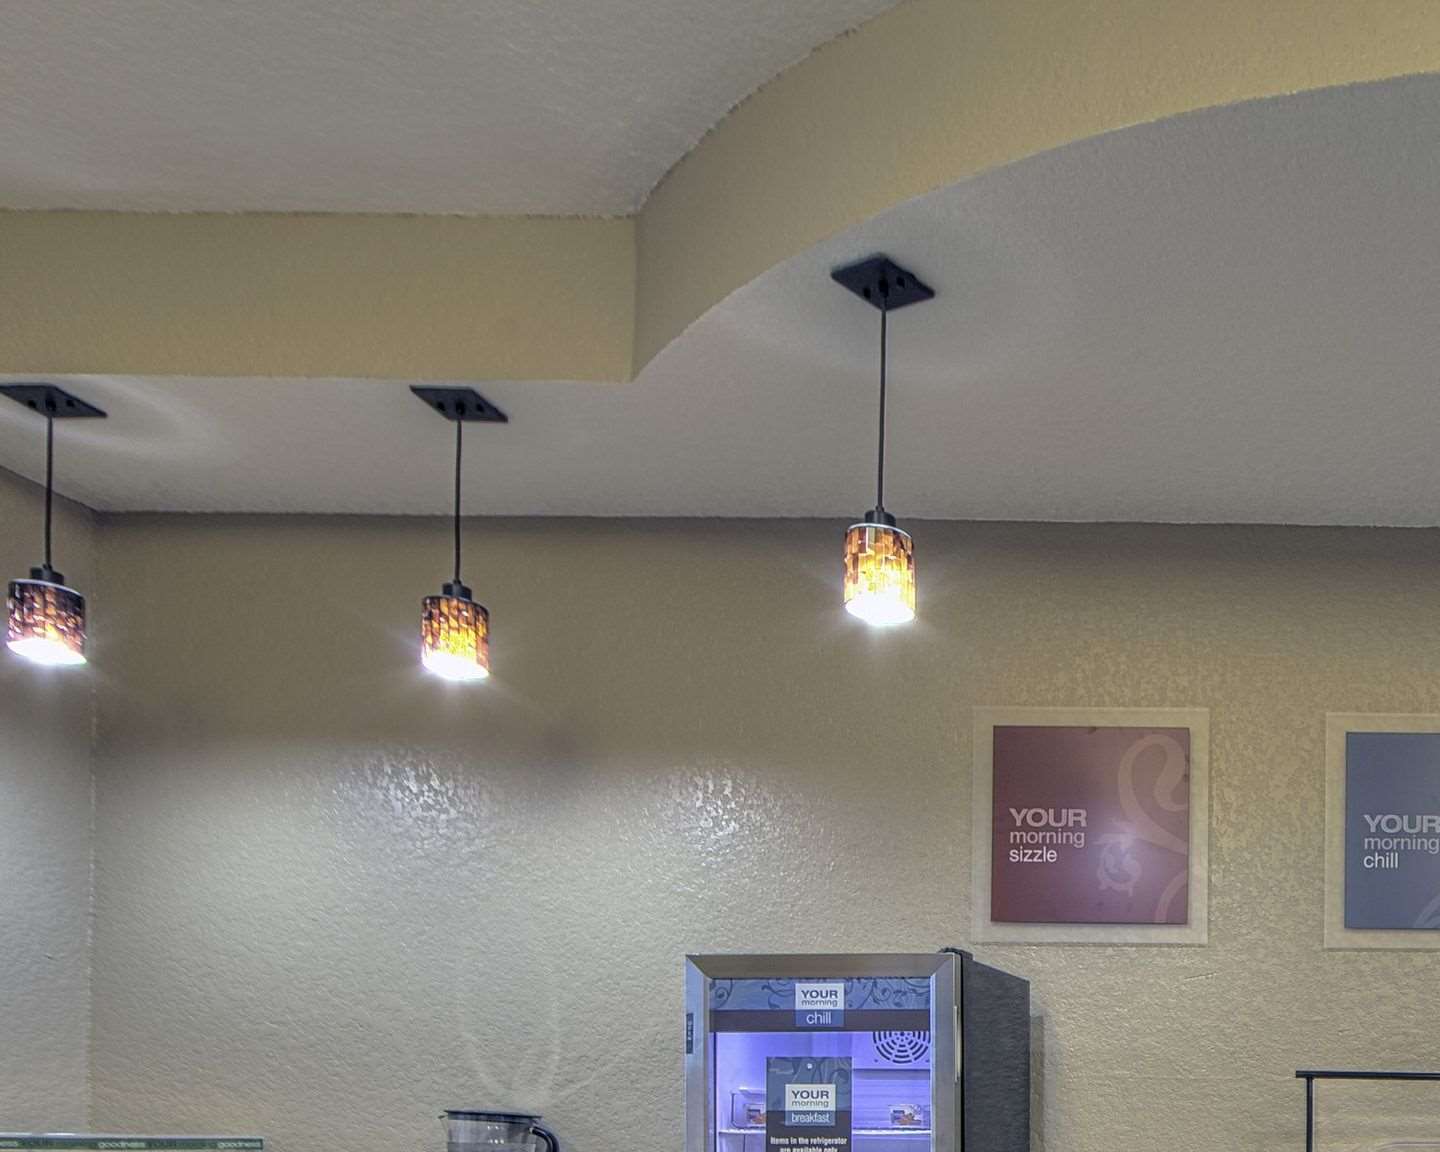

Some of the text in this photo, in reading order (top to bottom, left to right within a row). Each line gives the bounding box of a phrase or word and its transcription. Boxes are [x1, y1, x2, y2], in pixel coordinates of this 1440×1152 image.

[1009, 808, 1087, 827] YOUR
[1009, 829, 1085, 848] morning
[1364, 835, 1440, 854] morning
[1009, 846, 1058, 862] sizzle
[1363, 852, 1399, 868] chill
[801, 989, 838, 999] YOUR
[801, 999, 838, 1007] morning
[806, 1012, 832, 1025] chill
[791, 1090, 830, 1099] YOUR
[791, 1100, 829, 1108] morning
[791, 1112, 830, 1123] breakfast
